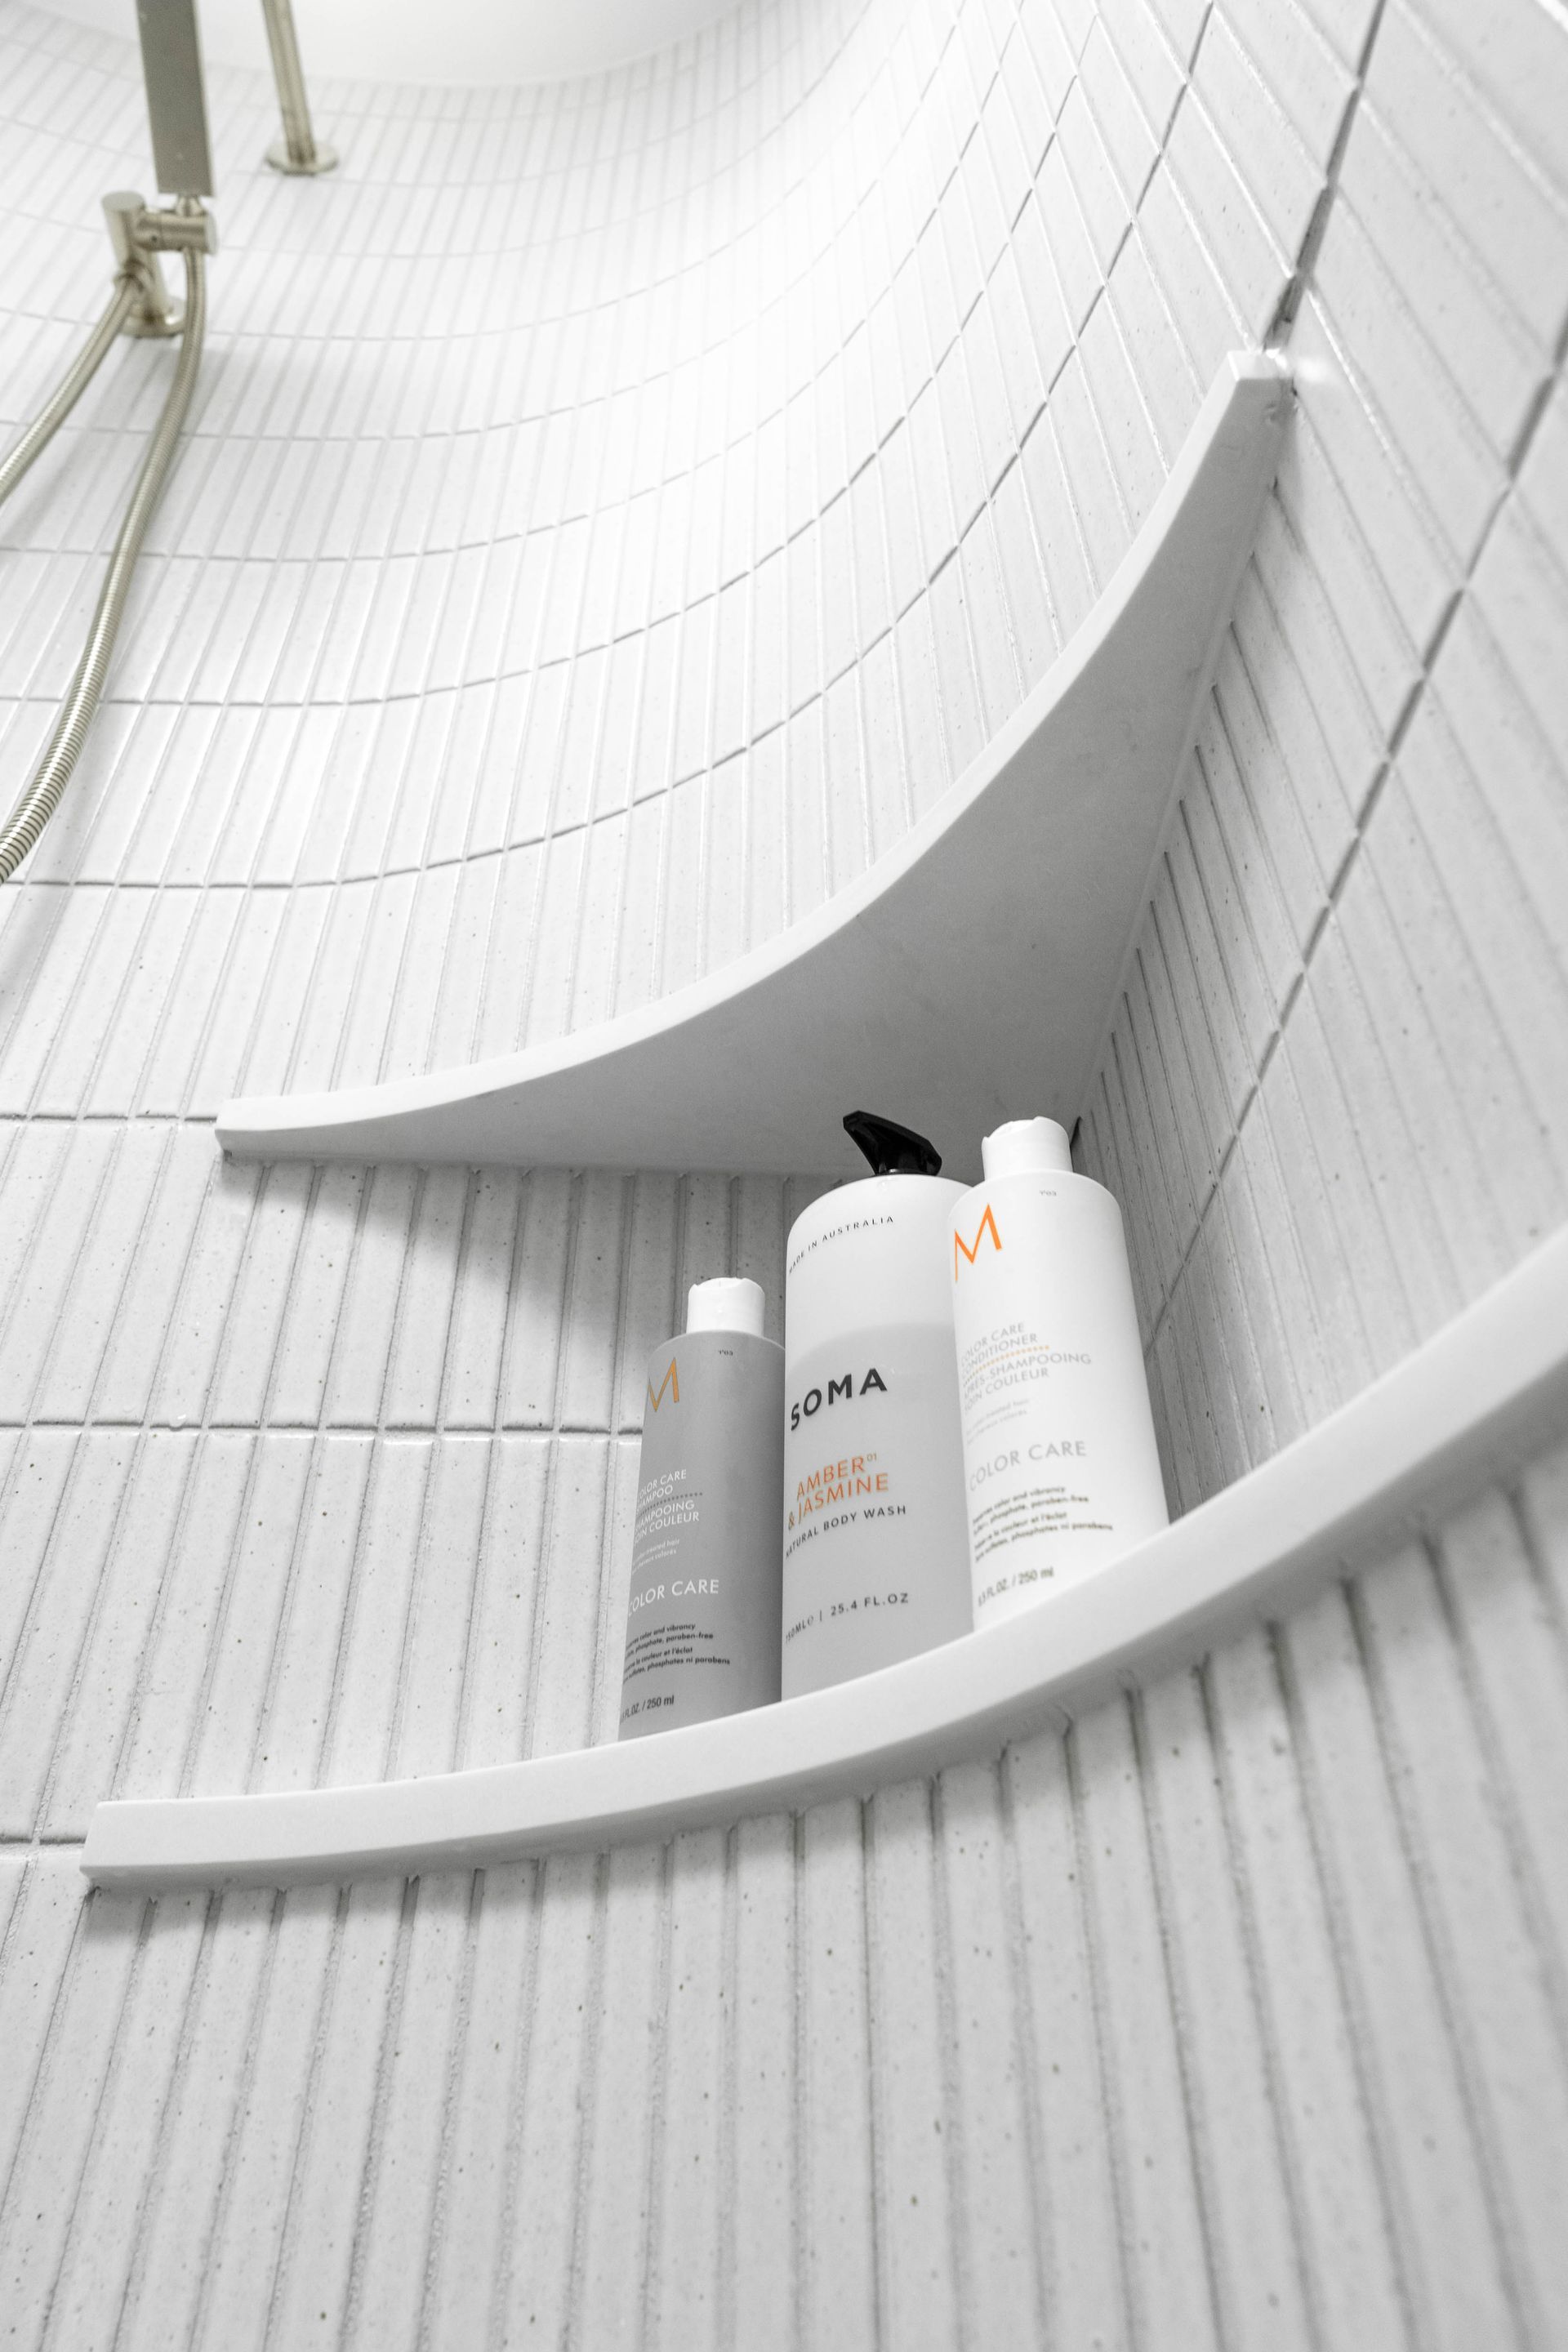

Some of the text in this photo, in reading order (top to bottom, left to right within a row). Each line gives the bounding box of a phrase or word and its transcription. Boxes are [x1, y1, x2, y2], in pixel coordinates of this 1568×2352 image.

[808, 1241, 817, 1251] IN
[822, 1215, 894, 1241] AUSTRALIA
[954, 1202, 1002, 1283] M
[991, 1321, 1026, 1341] CARE
[647, 1356, 680, 1412] M
[985, 1366, 1050, 1395] COULEUR
[791, 1367, 888, 1432] SOMA
[660, 1469, 687, 1486] CARE
[969, 1441, 1087, 1492] COLOR CARE
[797, 1454, 866, 1502] AMBER
[788, 1472, 889, 1531] & JASMINE
[649, 1511, 700, 1533] COULEUR
[786, 1505, 906, 1559] NATURAL BODY WASH
[671, 1579, 719, 1596] CARE
[1018, 1568, 1038, 1585] 250
[831, 1599, 858, 1616] 25.4
[666, 1623, 697, 1634] vibrancy
[666, 1632, 714, 1644] paraben-free
[694, 1655, 731, 1666] parabens
[647, 1696, 662, 1710] 250
[663, 1695, 675, 1706] ml
